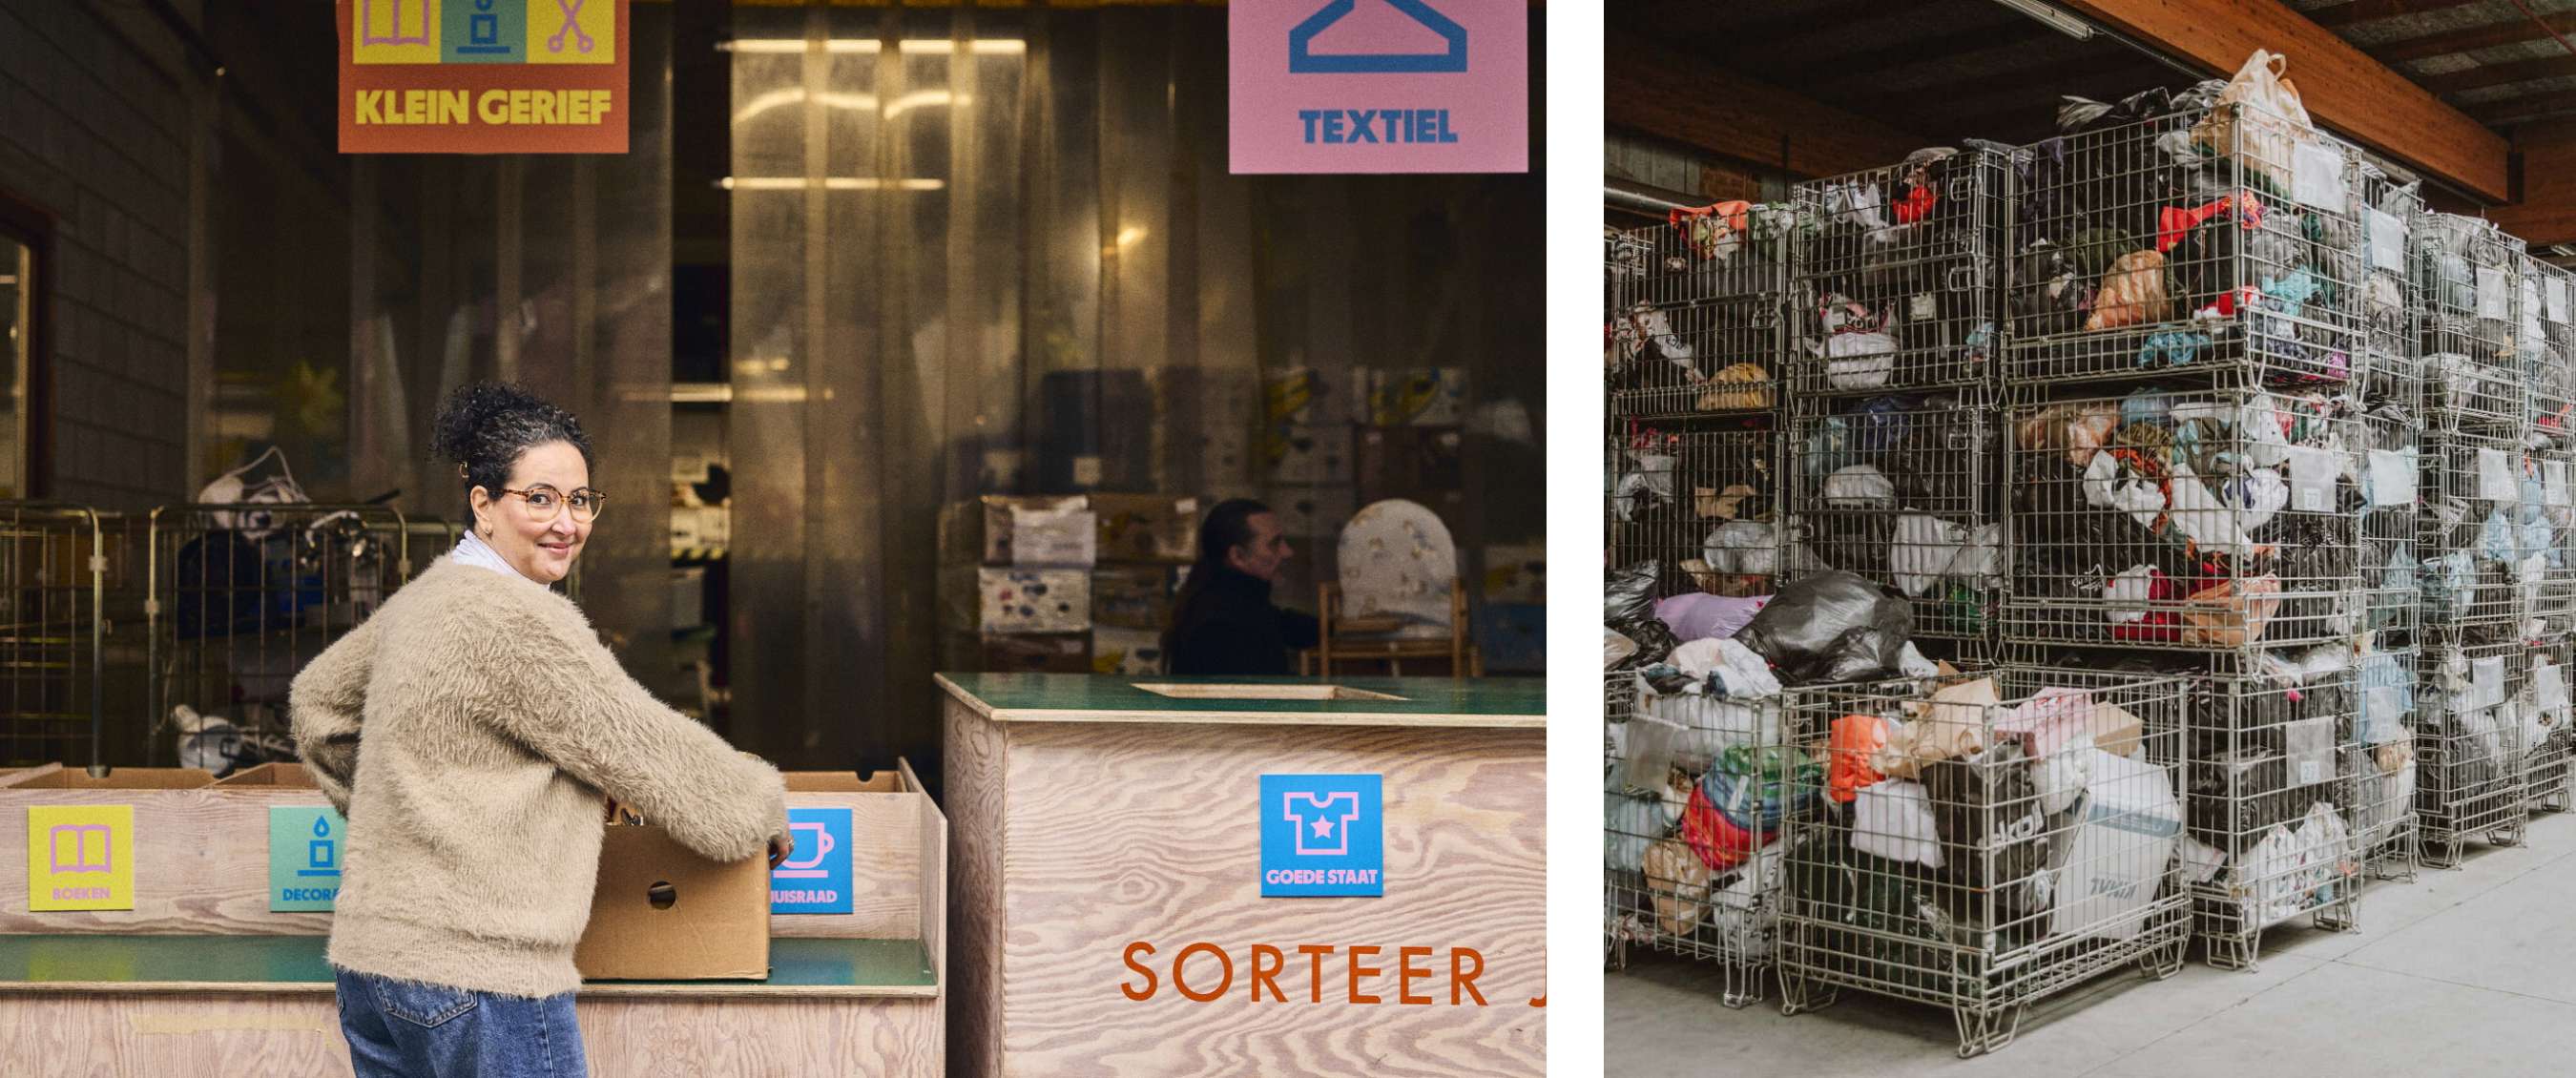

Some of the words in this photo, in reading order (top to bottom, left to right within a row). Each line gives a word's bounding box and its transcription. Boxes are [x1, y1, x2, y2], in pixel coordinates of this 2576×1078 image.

[355, 90, 469, 124] KLEIN
[477, 89, 612, 124] GERIEF
[1298, 109, 1459, 143] TEXTIEL
[52, 887, 111, 900] BOEKEN
[1266, 870, 1325, 884] GOEDE
[1327, 870, 1378, 884] STAAT
[1120, 941, 1488, 1006] SORTEER
